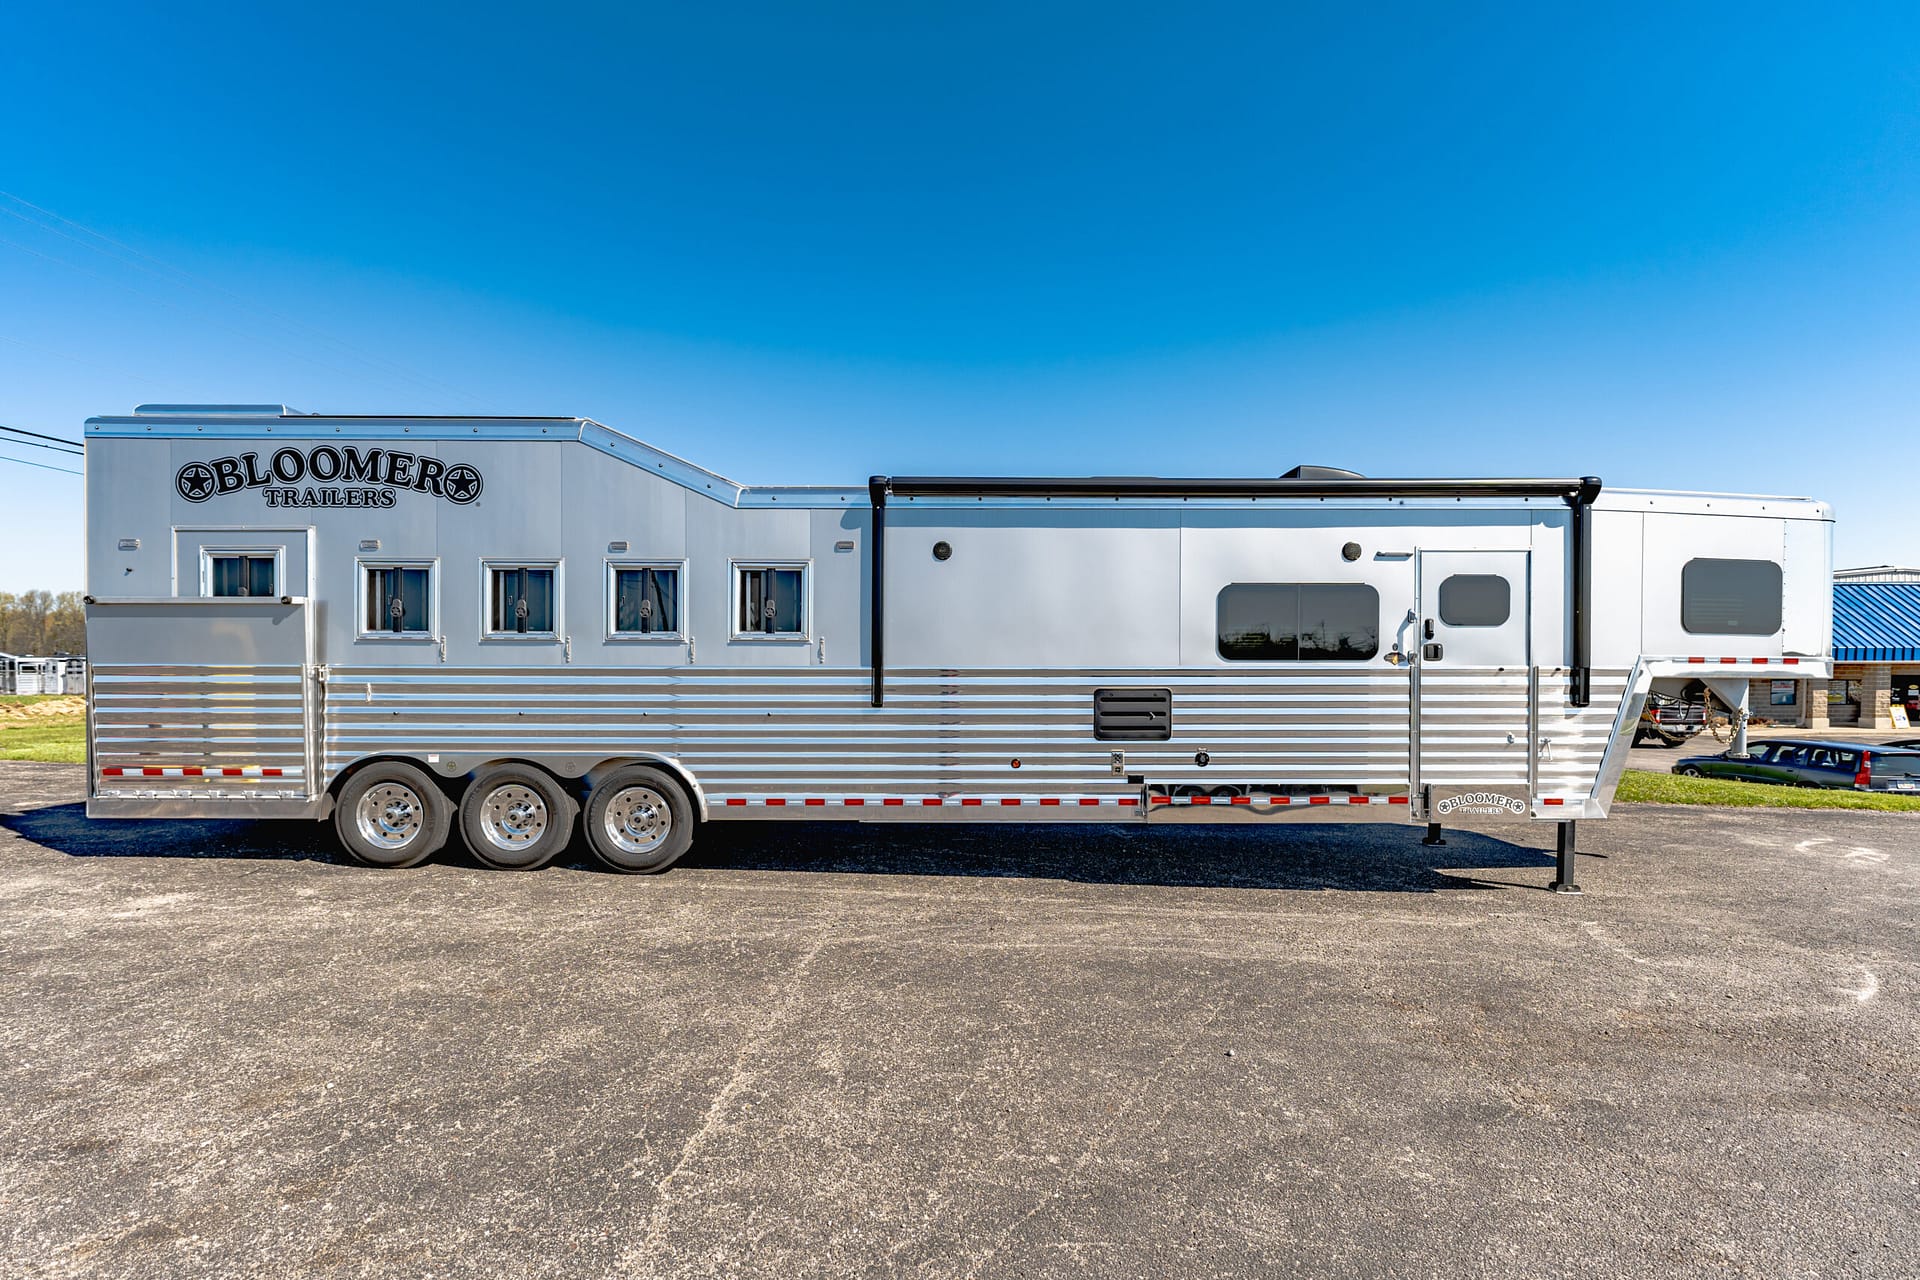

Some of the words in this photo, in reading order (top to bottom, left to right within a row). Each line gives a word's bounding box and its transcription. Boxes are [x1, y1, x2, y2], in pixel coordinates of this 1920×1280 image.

[211, 445, 447, 497] BLOOMER
[263, 487, 397, 509] TRAILERS
[1449, 793, 1513, 810] BLOOMER
[1459, 806, 1503, 815] TRAILERS
